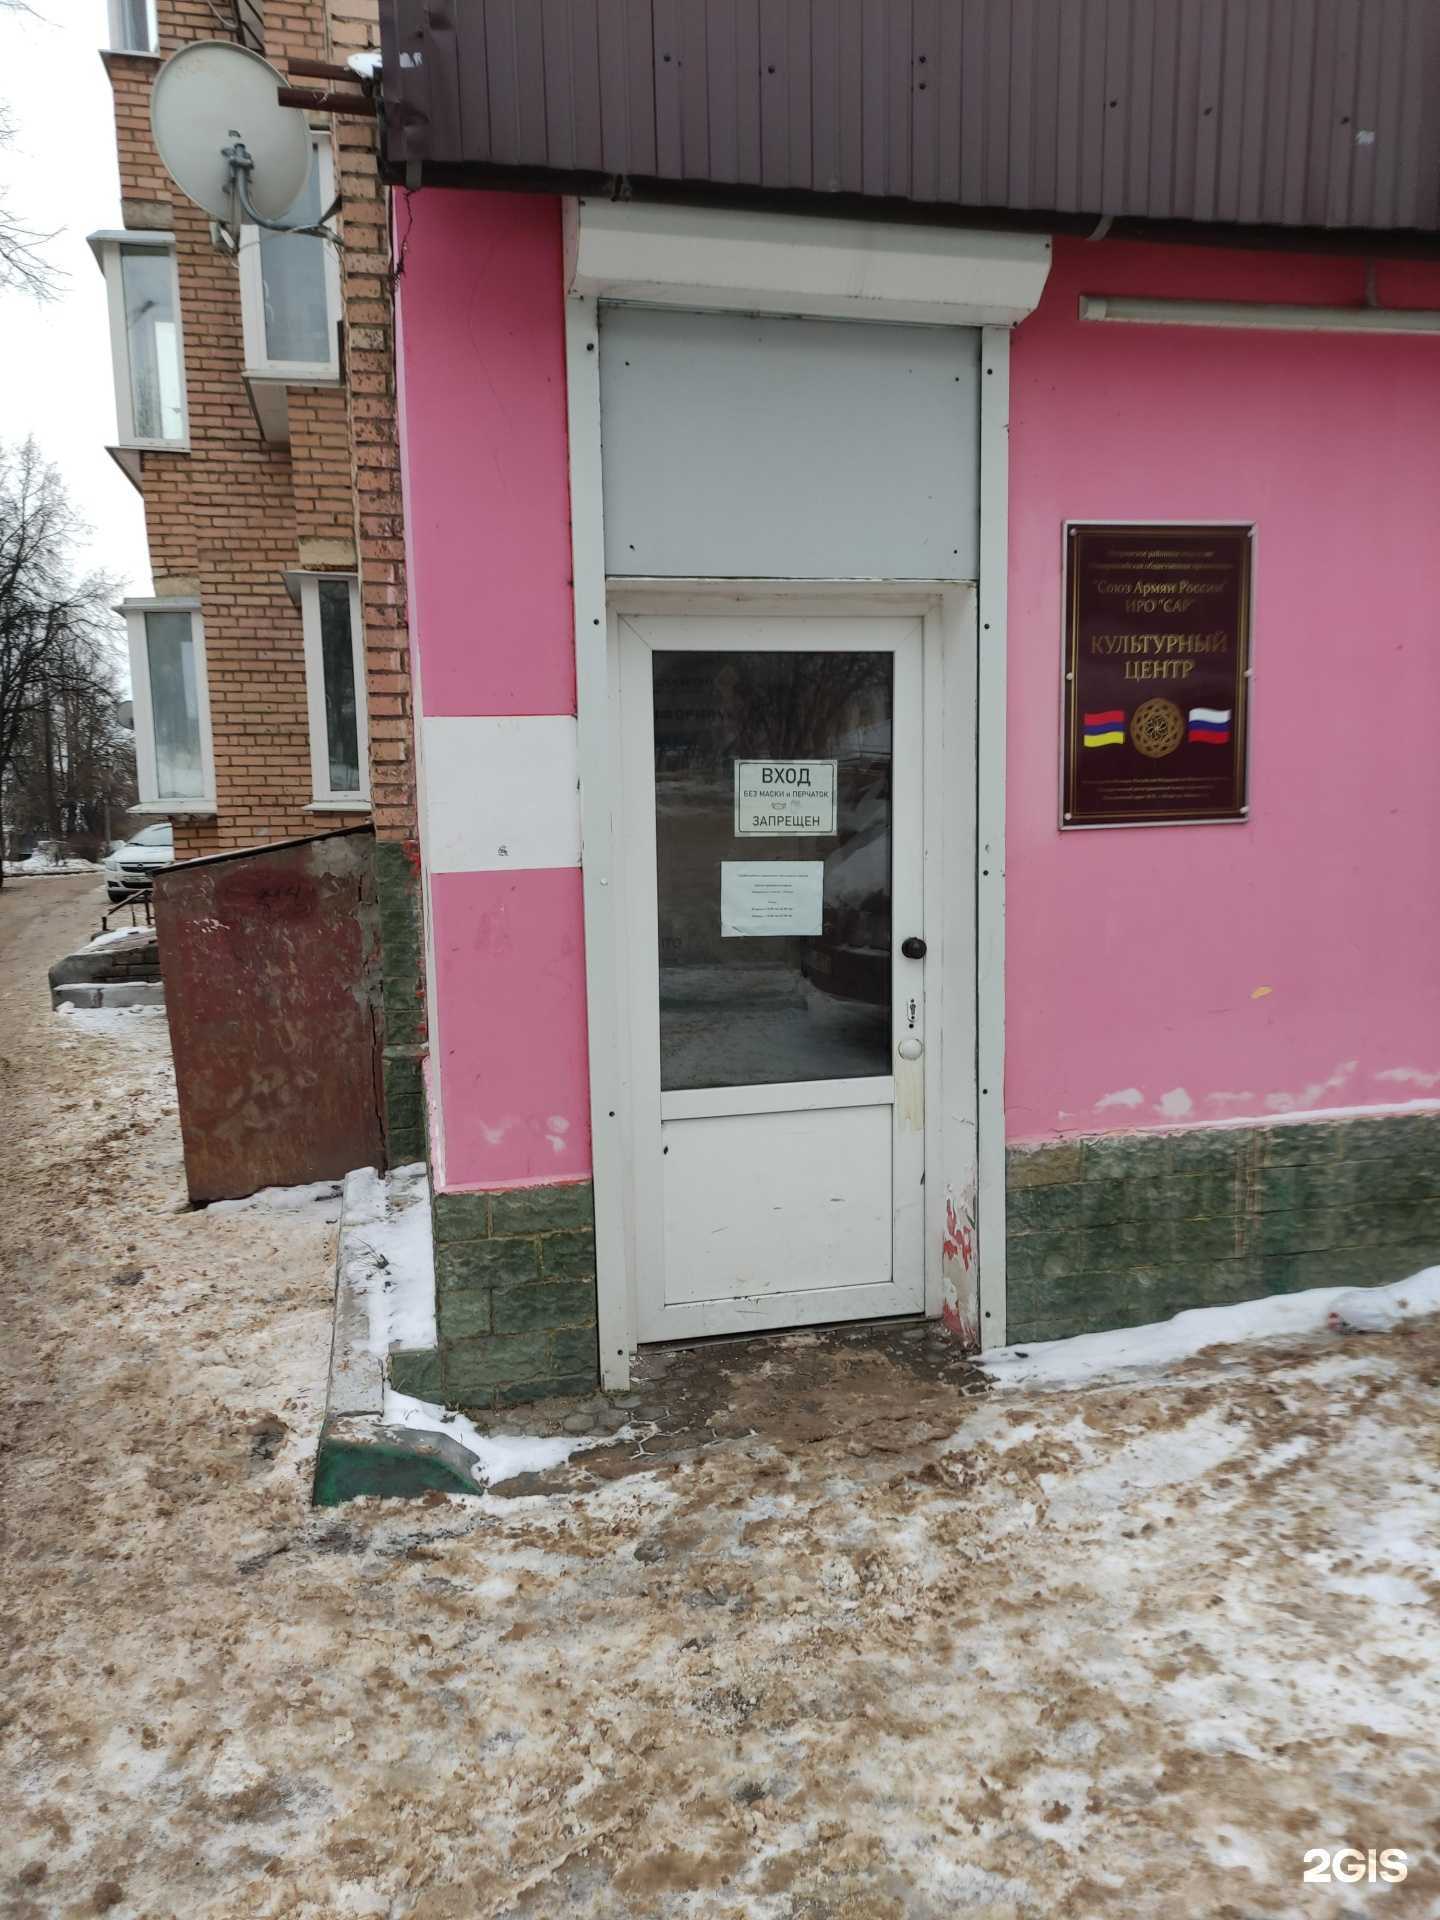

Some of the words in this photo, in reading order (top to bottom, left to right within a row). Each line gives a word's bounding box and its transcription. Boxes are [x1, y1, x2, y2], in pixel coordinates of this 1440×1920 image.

[1134, 580, 1175, 597] Армян
[1090, 631, 1228, 654] КУЛЬТУРНЫЙ
[1124, 660, 1196, 682] ЦЕНТР
[762, 768, 811, 787] ВХОД
[743, 790, 758, 798] БЕЗ
[760, 790, 785, 798] МАСКИ
[792, 790, 829, 798] ПЕРЧАТОК
[752, 816, 821, 828] ЗАПРЕЩЕН
